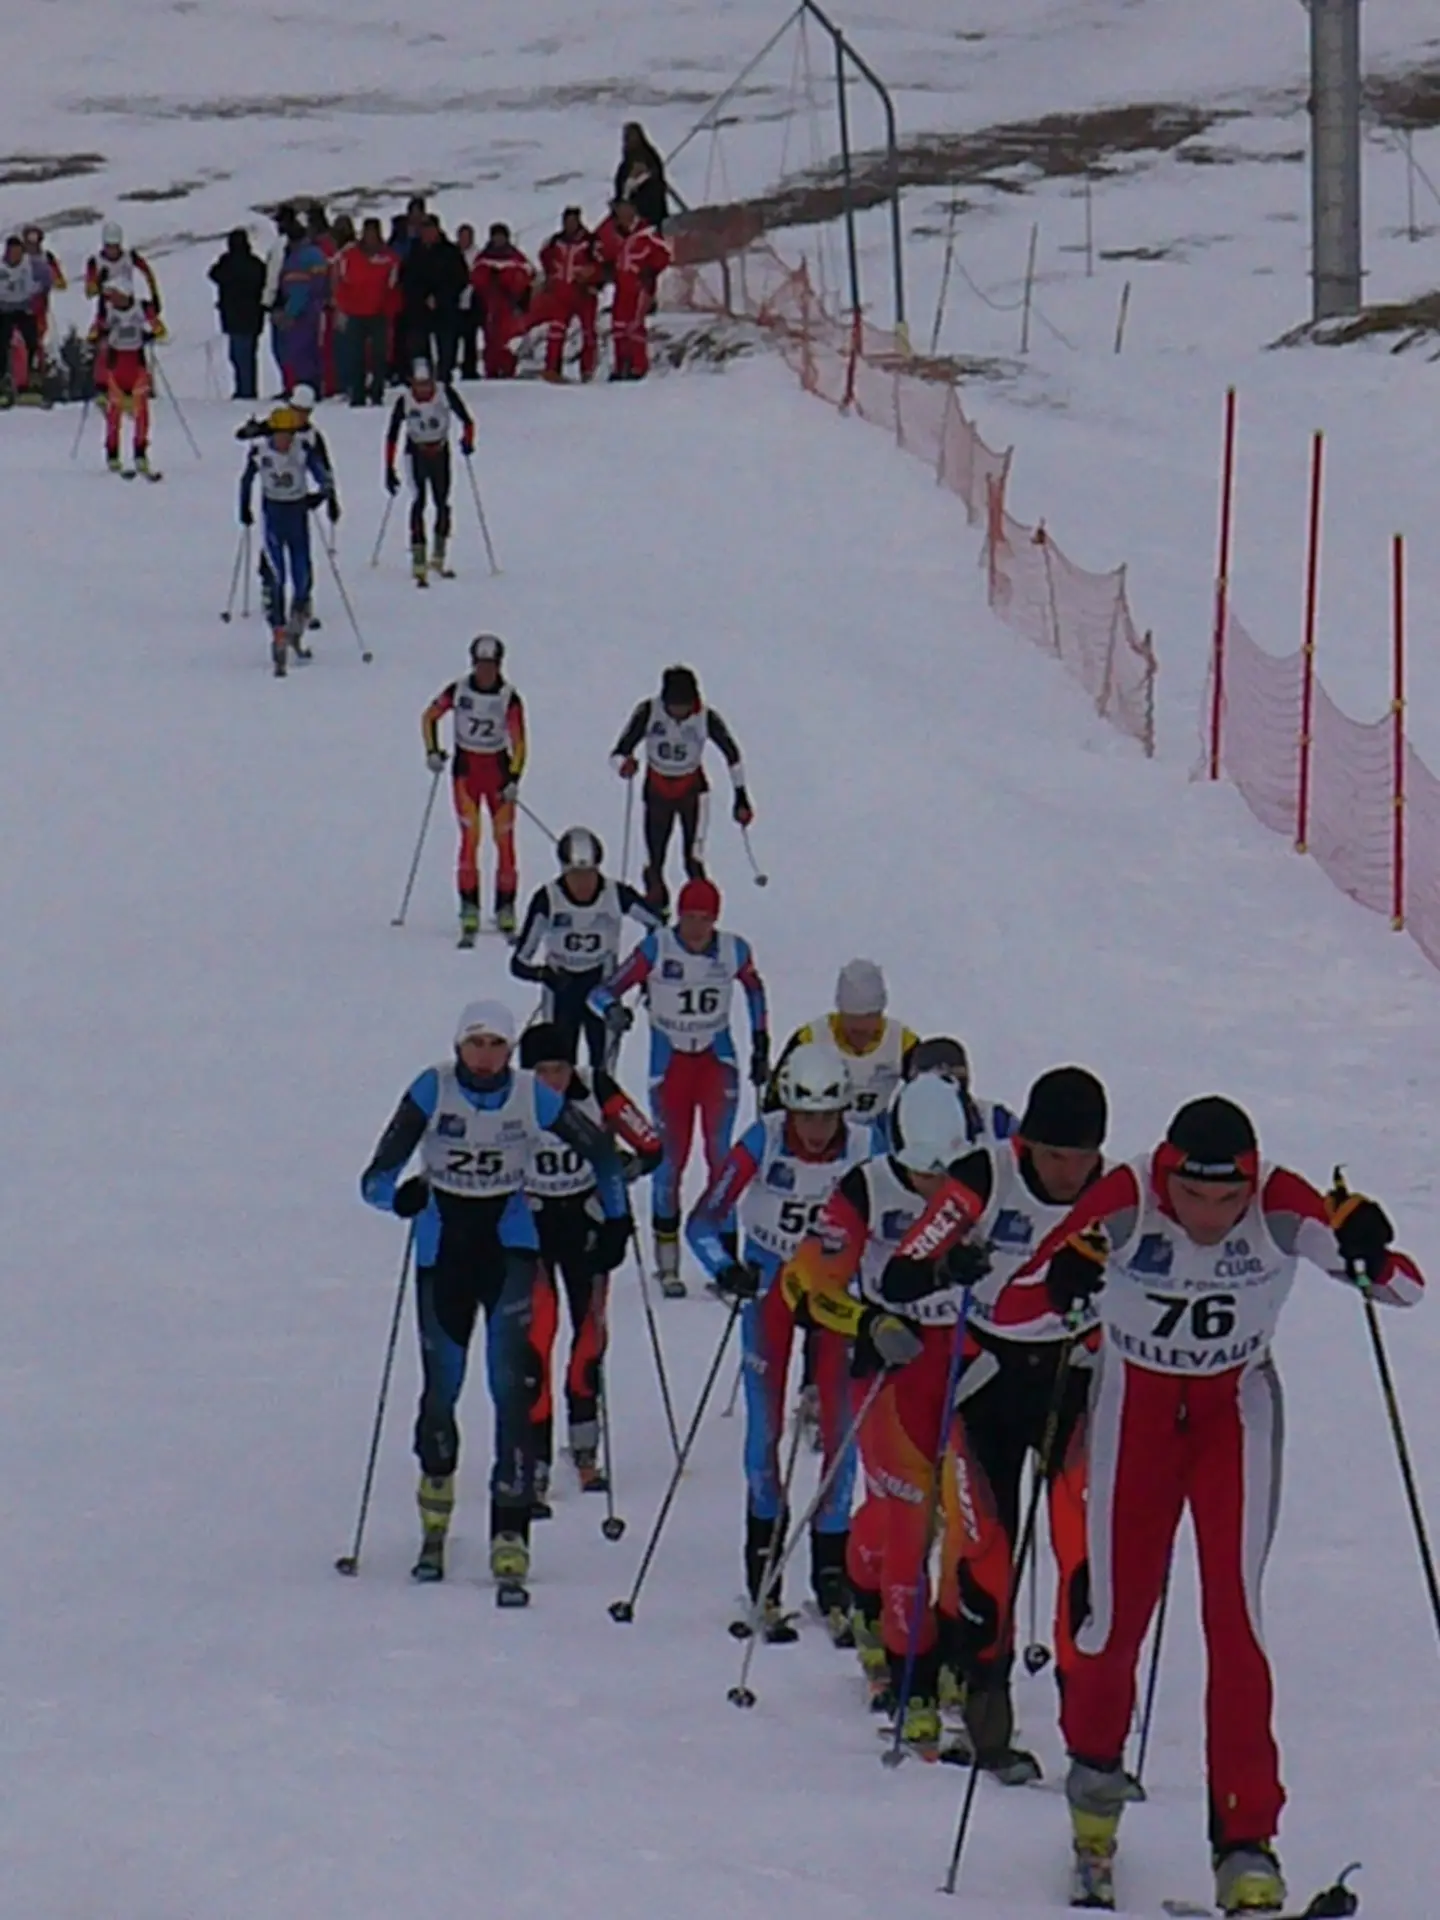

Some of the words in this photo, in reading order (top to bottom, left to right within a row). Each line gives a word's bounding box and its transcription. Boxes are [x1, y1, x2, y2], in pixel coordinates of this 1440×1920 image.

[467, 717, 497, 738] 72
[677, 988, 720, 1016] 16
[446, 1150, 504, 1177] 25
[1145, 1292, 1238, 1341] 76
